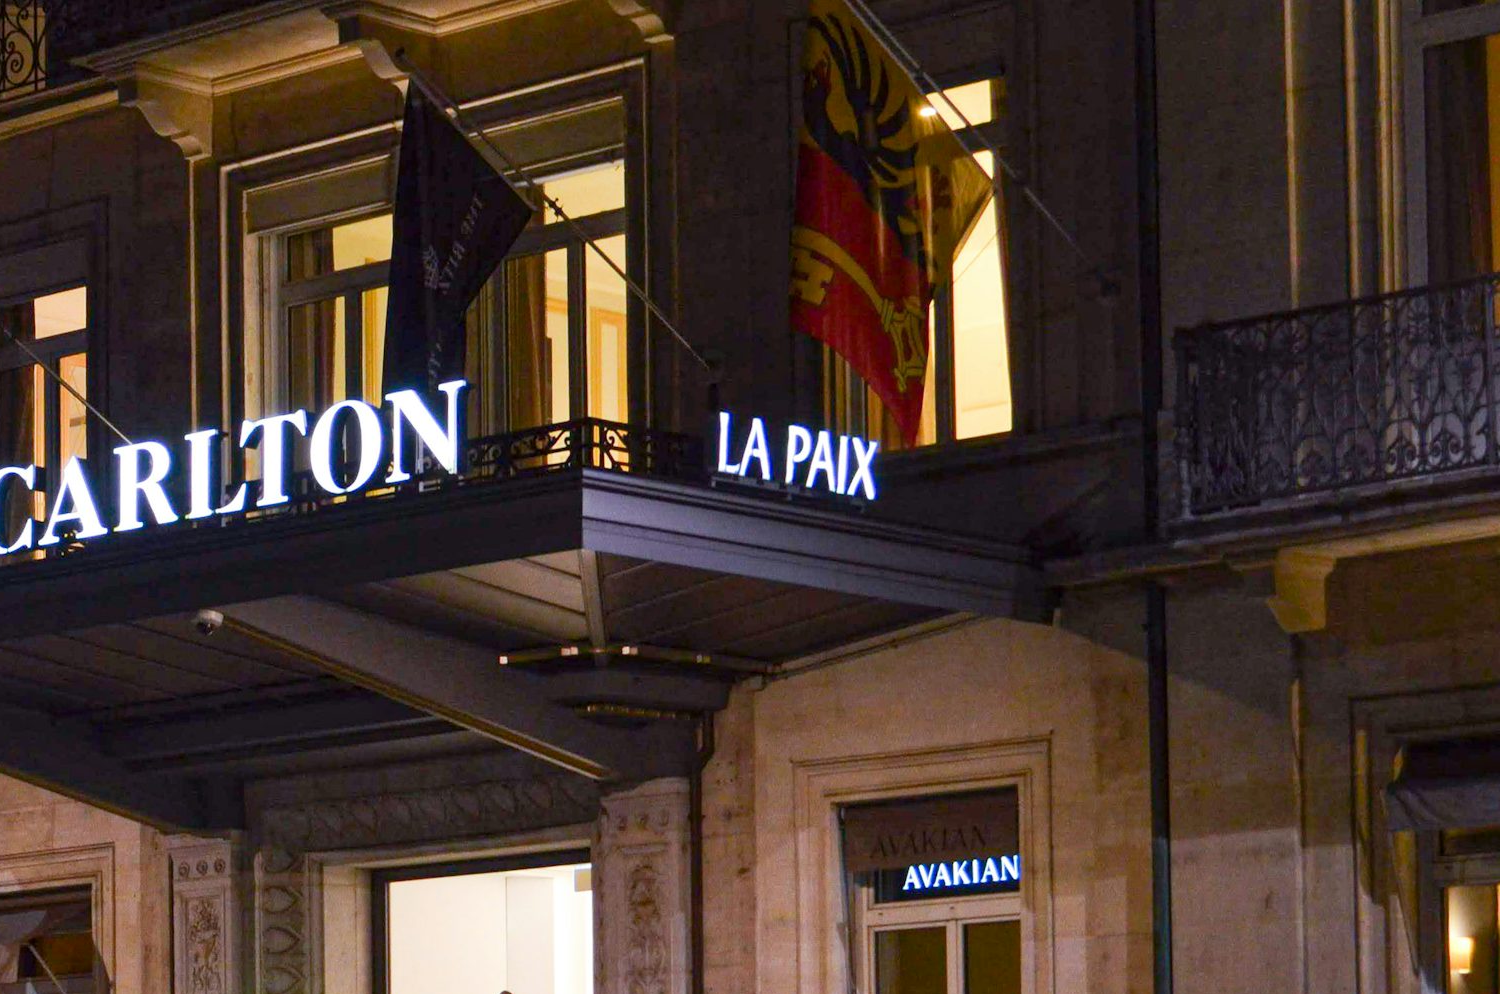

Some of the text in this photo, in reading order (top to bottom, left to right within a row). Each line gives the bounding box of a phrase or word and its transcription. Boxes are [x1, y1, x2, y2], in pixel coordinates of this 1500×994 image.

[717, 411, 878, 500] LA PAIX
[869, 824, 987, 861] AVAKIAN
[902, 854, 1020, 890] AVAKIAN
